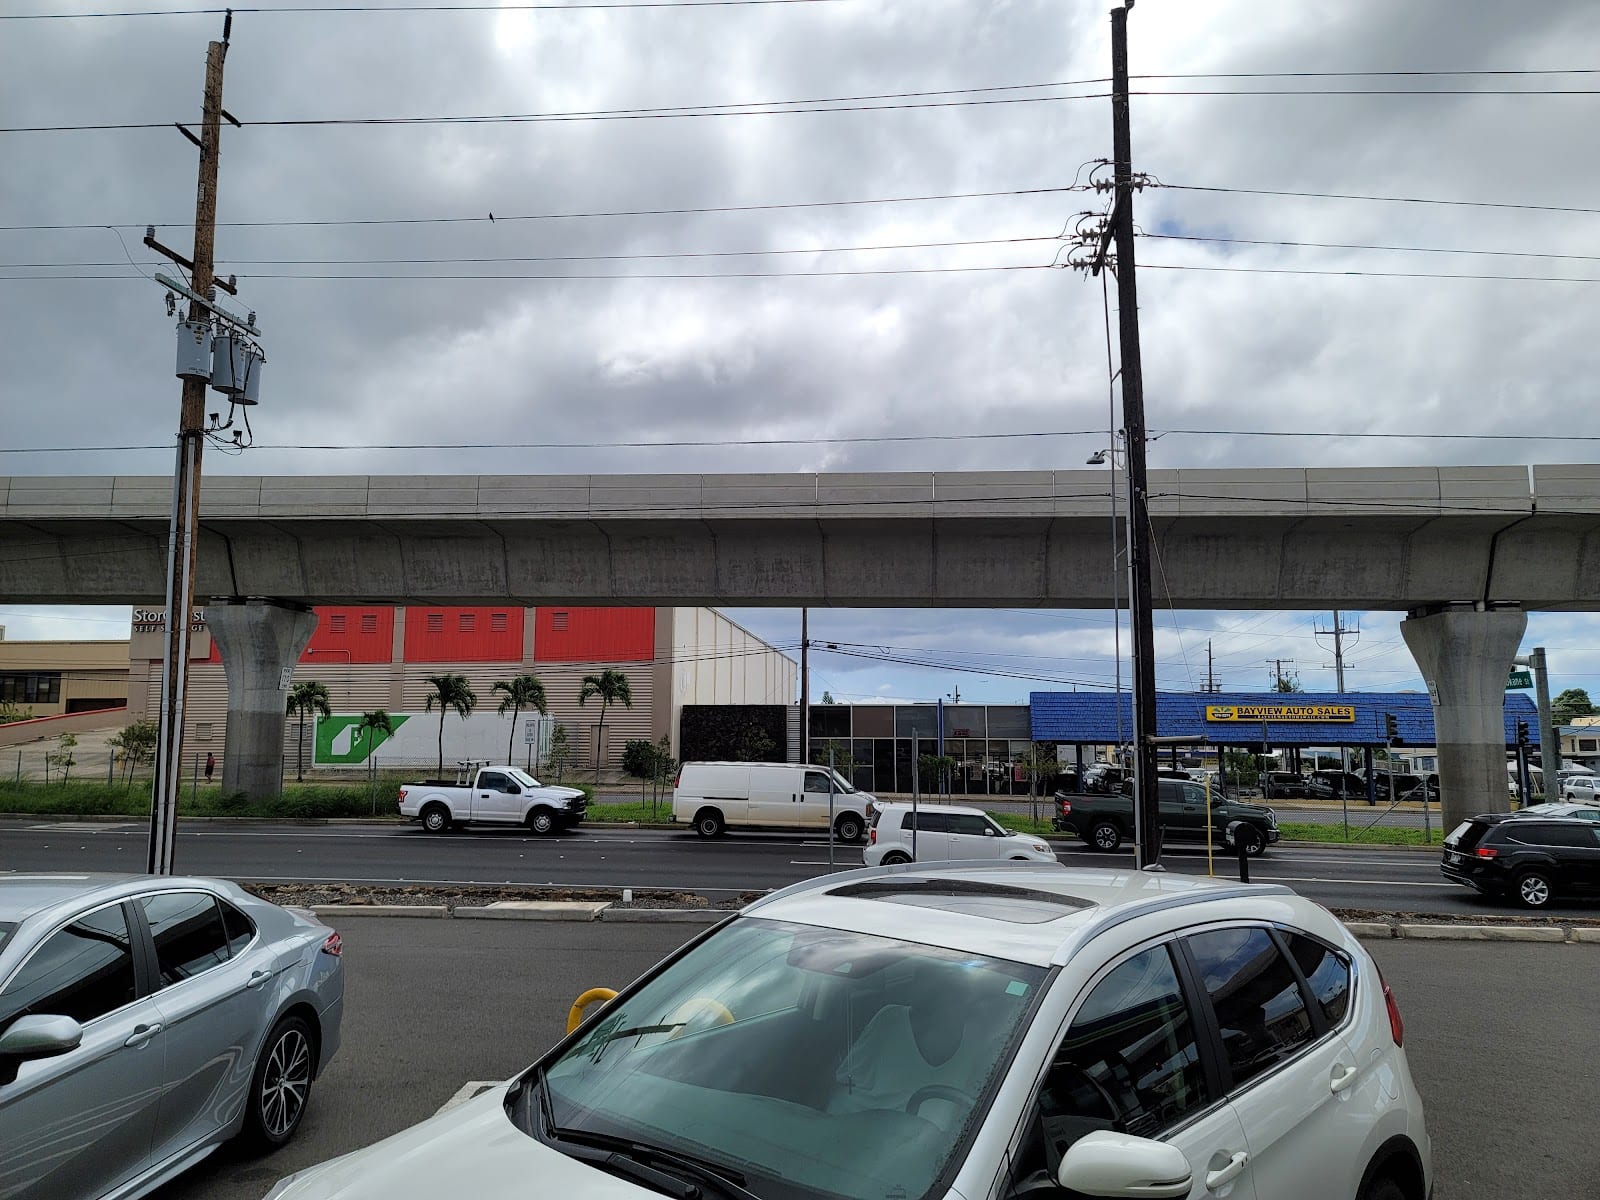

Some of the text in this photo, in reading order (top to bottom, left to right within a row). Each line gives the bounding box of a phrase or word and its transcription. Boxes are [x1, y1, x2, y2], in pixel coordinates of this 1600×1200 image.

[1237, 707, 1351, 715] BAYVIEW AUTO SALES
